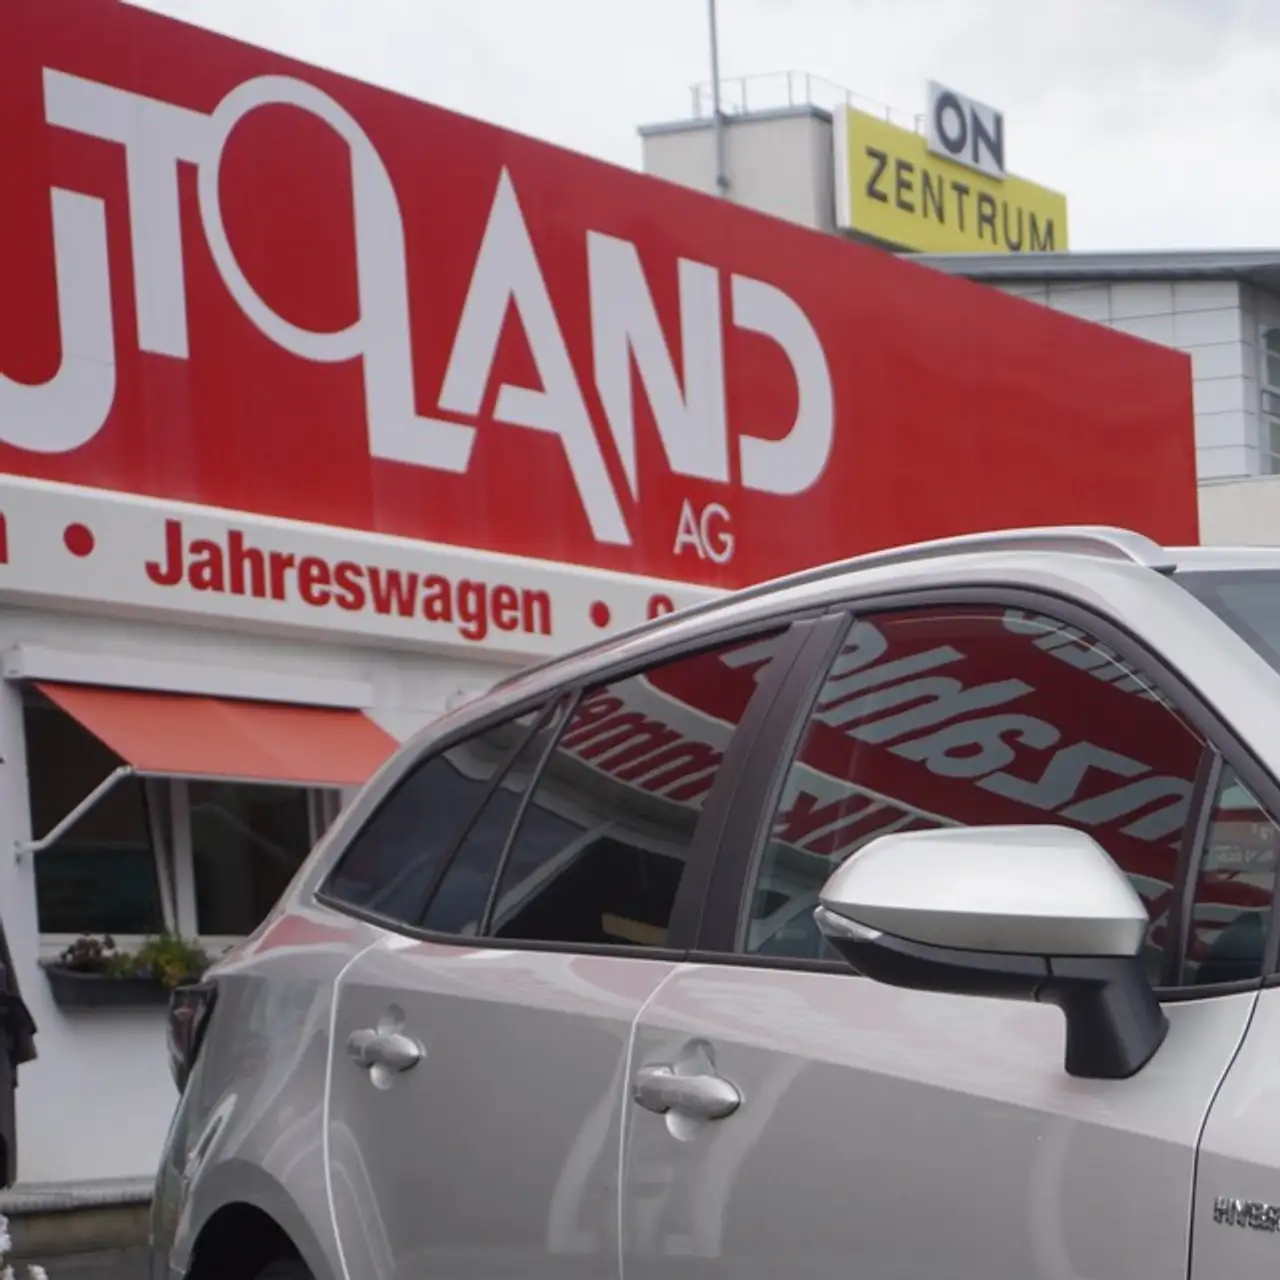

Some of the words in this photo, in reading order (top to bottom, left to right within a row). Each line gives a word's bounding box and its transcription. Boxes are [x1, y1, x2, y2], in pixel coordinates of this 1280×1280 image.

[934, 91, 1004, 172] ON
[865, 144, 1054, 252] ZENTRUM
[145, 519, 552, 640] Jahreswagen
[673, 501, 734, 564] AG
